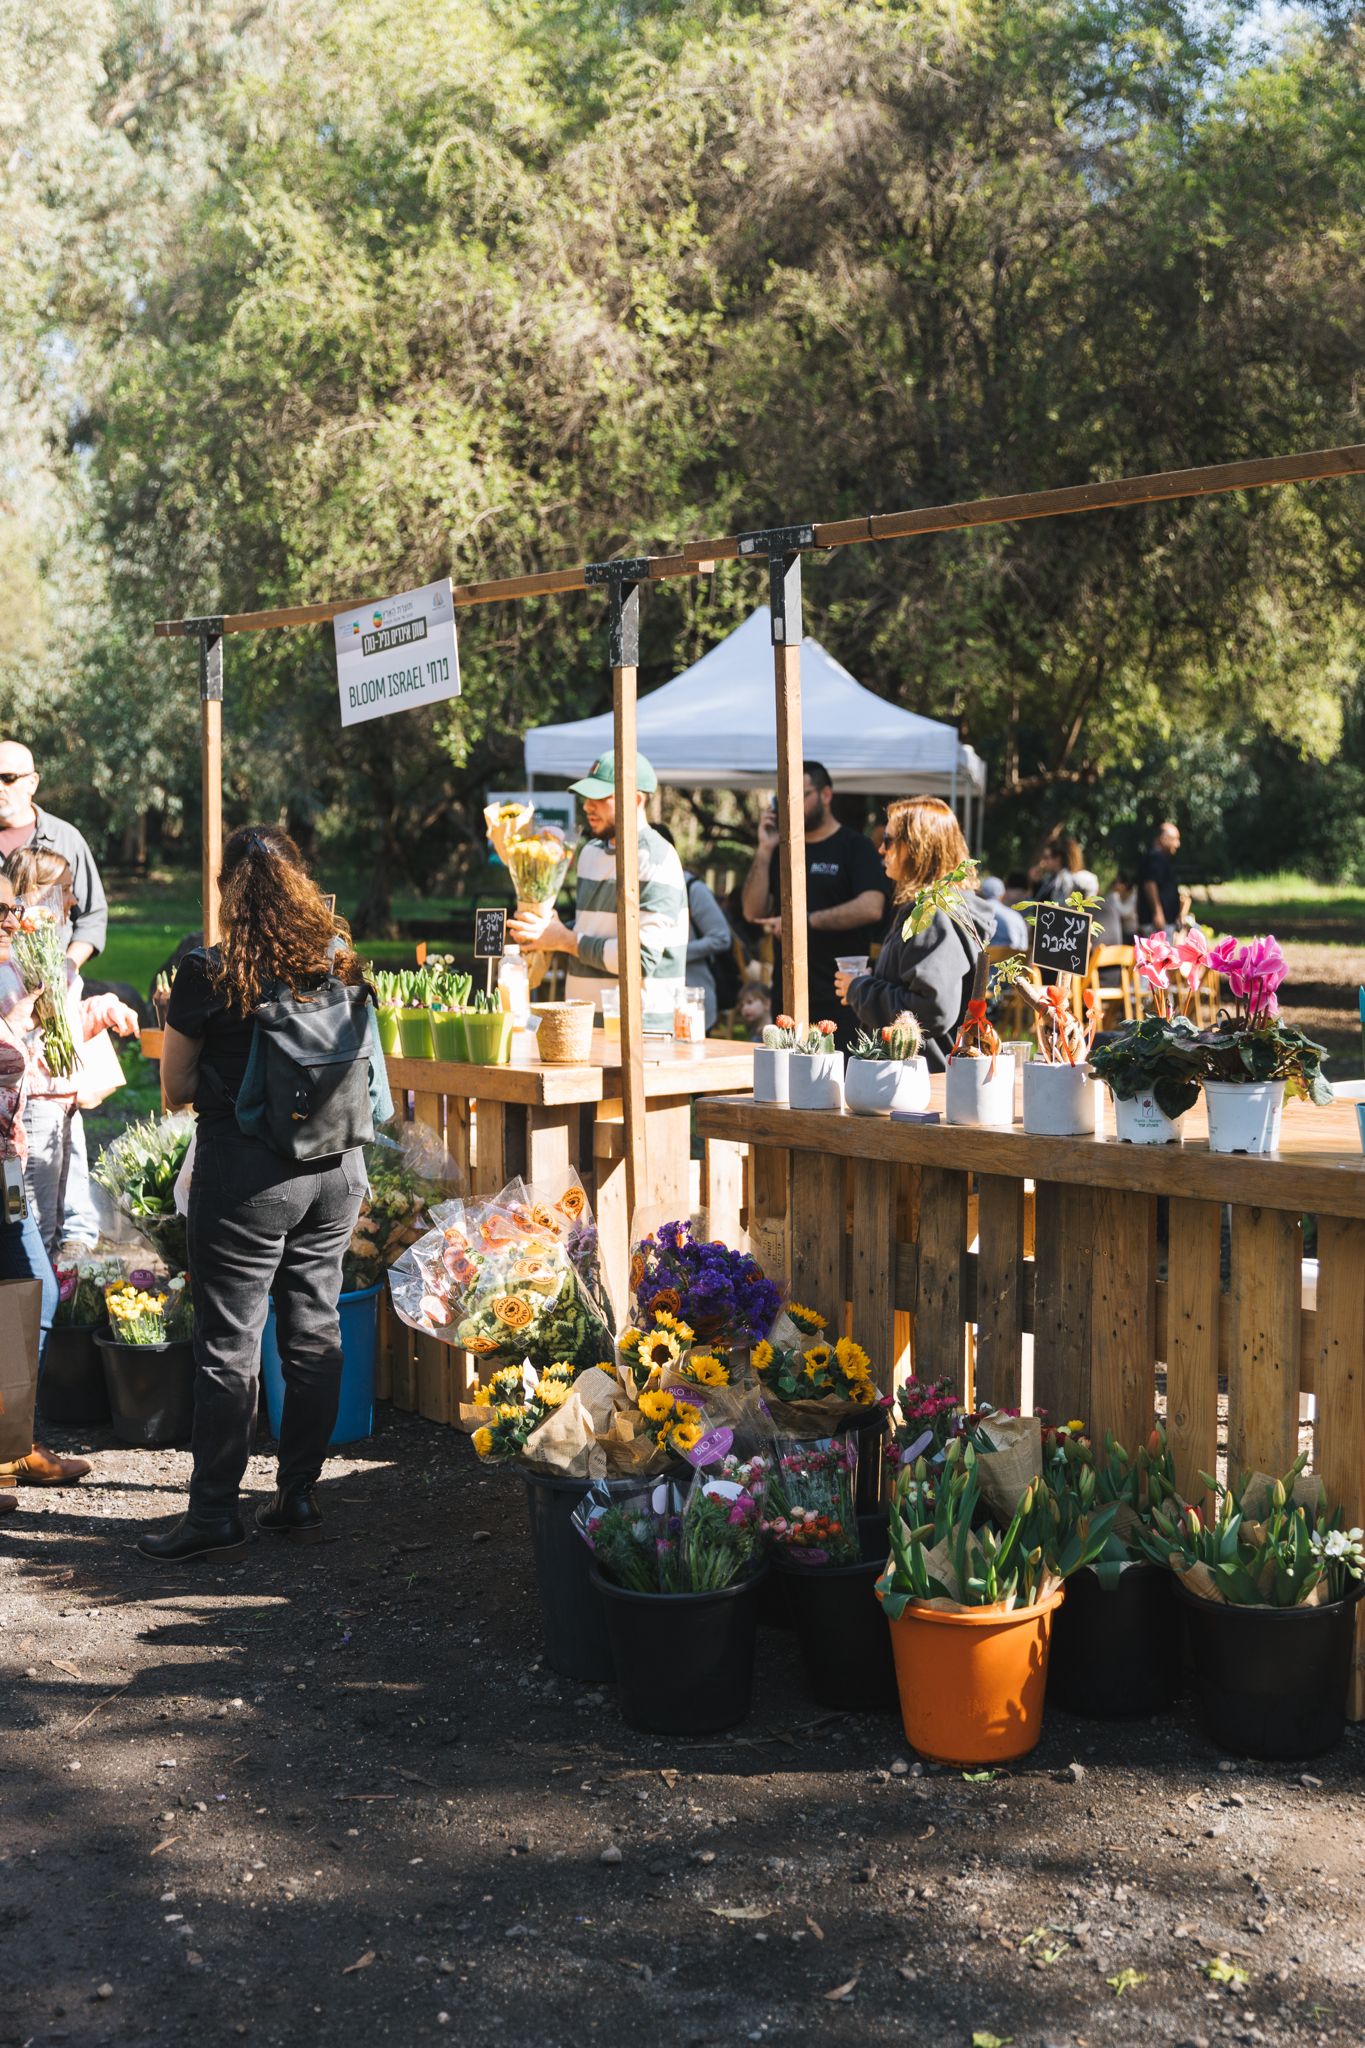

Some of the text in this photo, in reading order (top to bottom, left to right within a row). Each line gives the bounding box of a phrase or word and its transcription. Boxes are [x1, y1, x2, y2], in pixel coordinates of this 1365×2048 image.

[411, 620, 425, 640] שוק
[348, 657, 450, 708] פרחי BLOOM ISRAEL
[1063, 916, 1086, 939] עץ
[1041, 933, 1077, 952] אהבה
